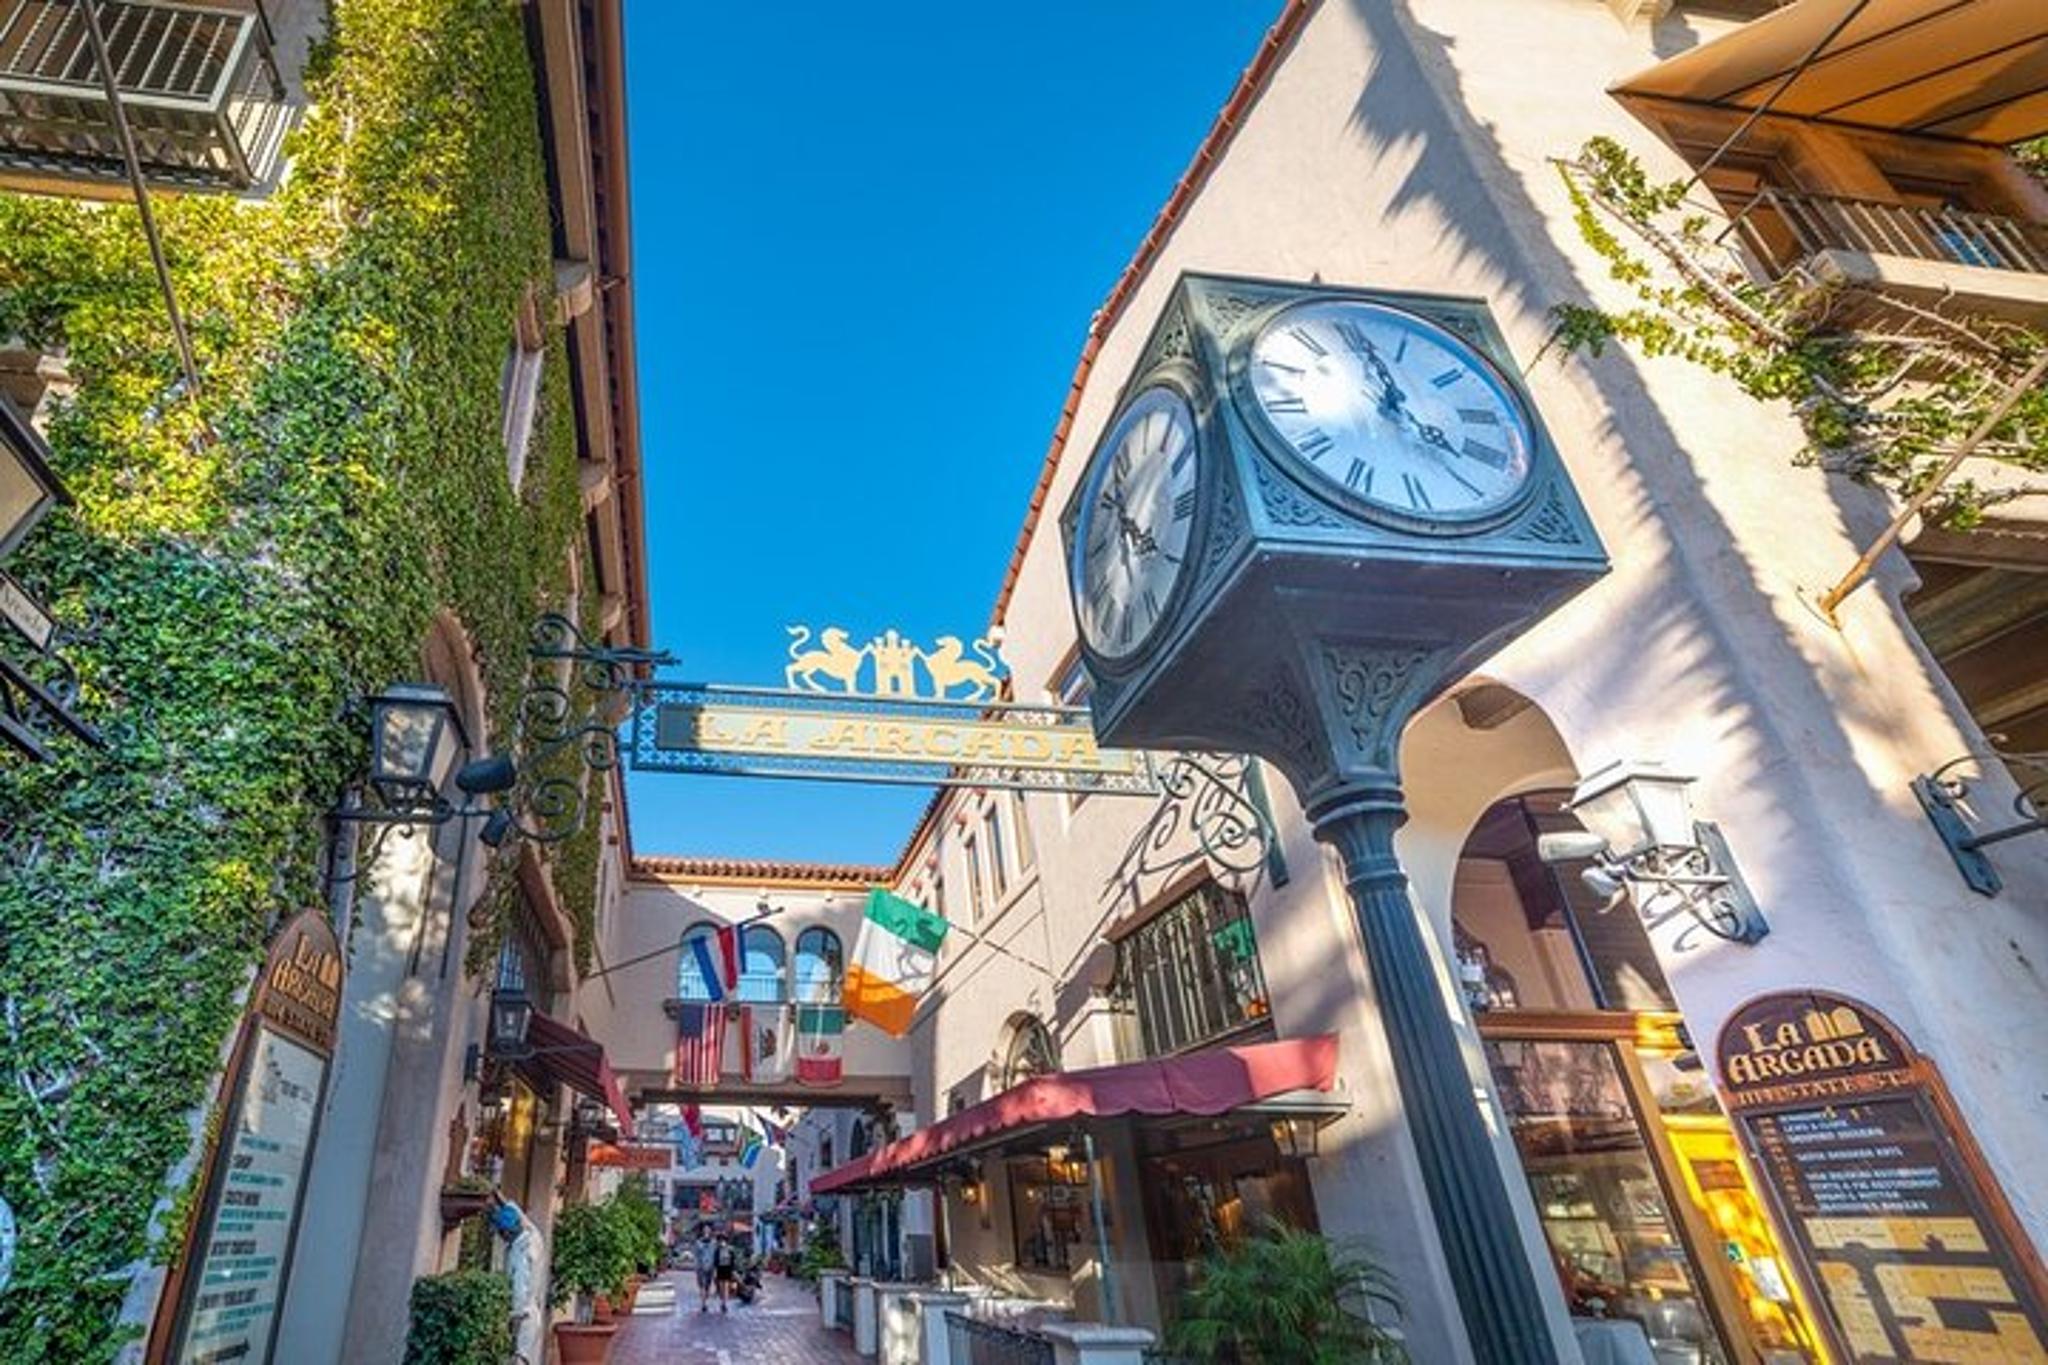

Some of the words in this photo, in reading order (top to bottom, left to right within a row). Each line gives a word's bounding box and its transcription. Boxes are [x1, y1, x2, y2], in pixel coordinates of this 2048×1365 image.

[696, 711, 788, 748] LA
[808, 718, 1101, 766] ARCADA
[1727, 1036, 1889, 1085] ARCADA
[1743, 1022, 1803, 1053] LA
